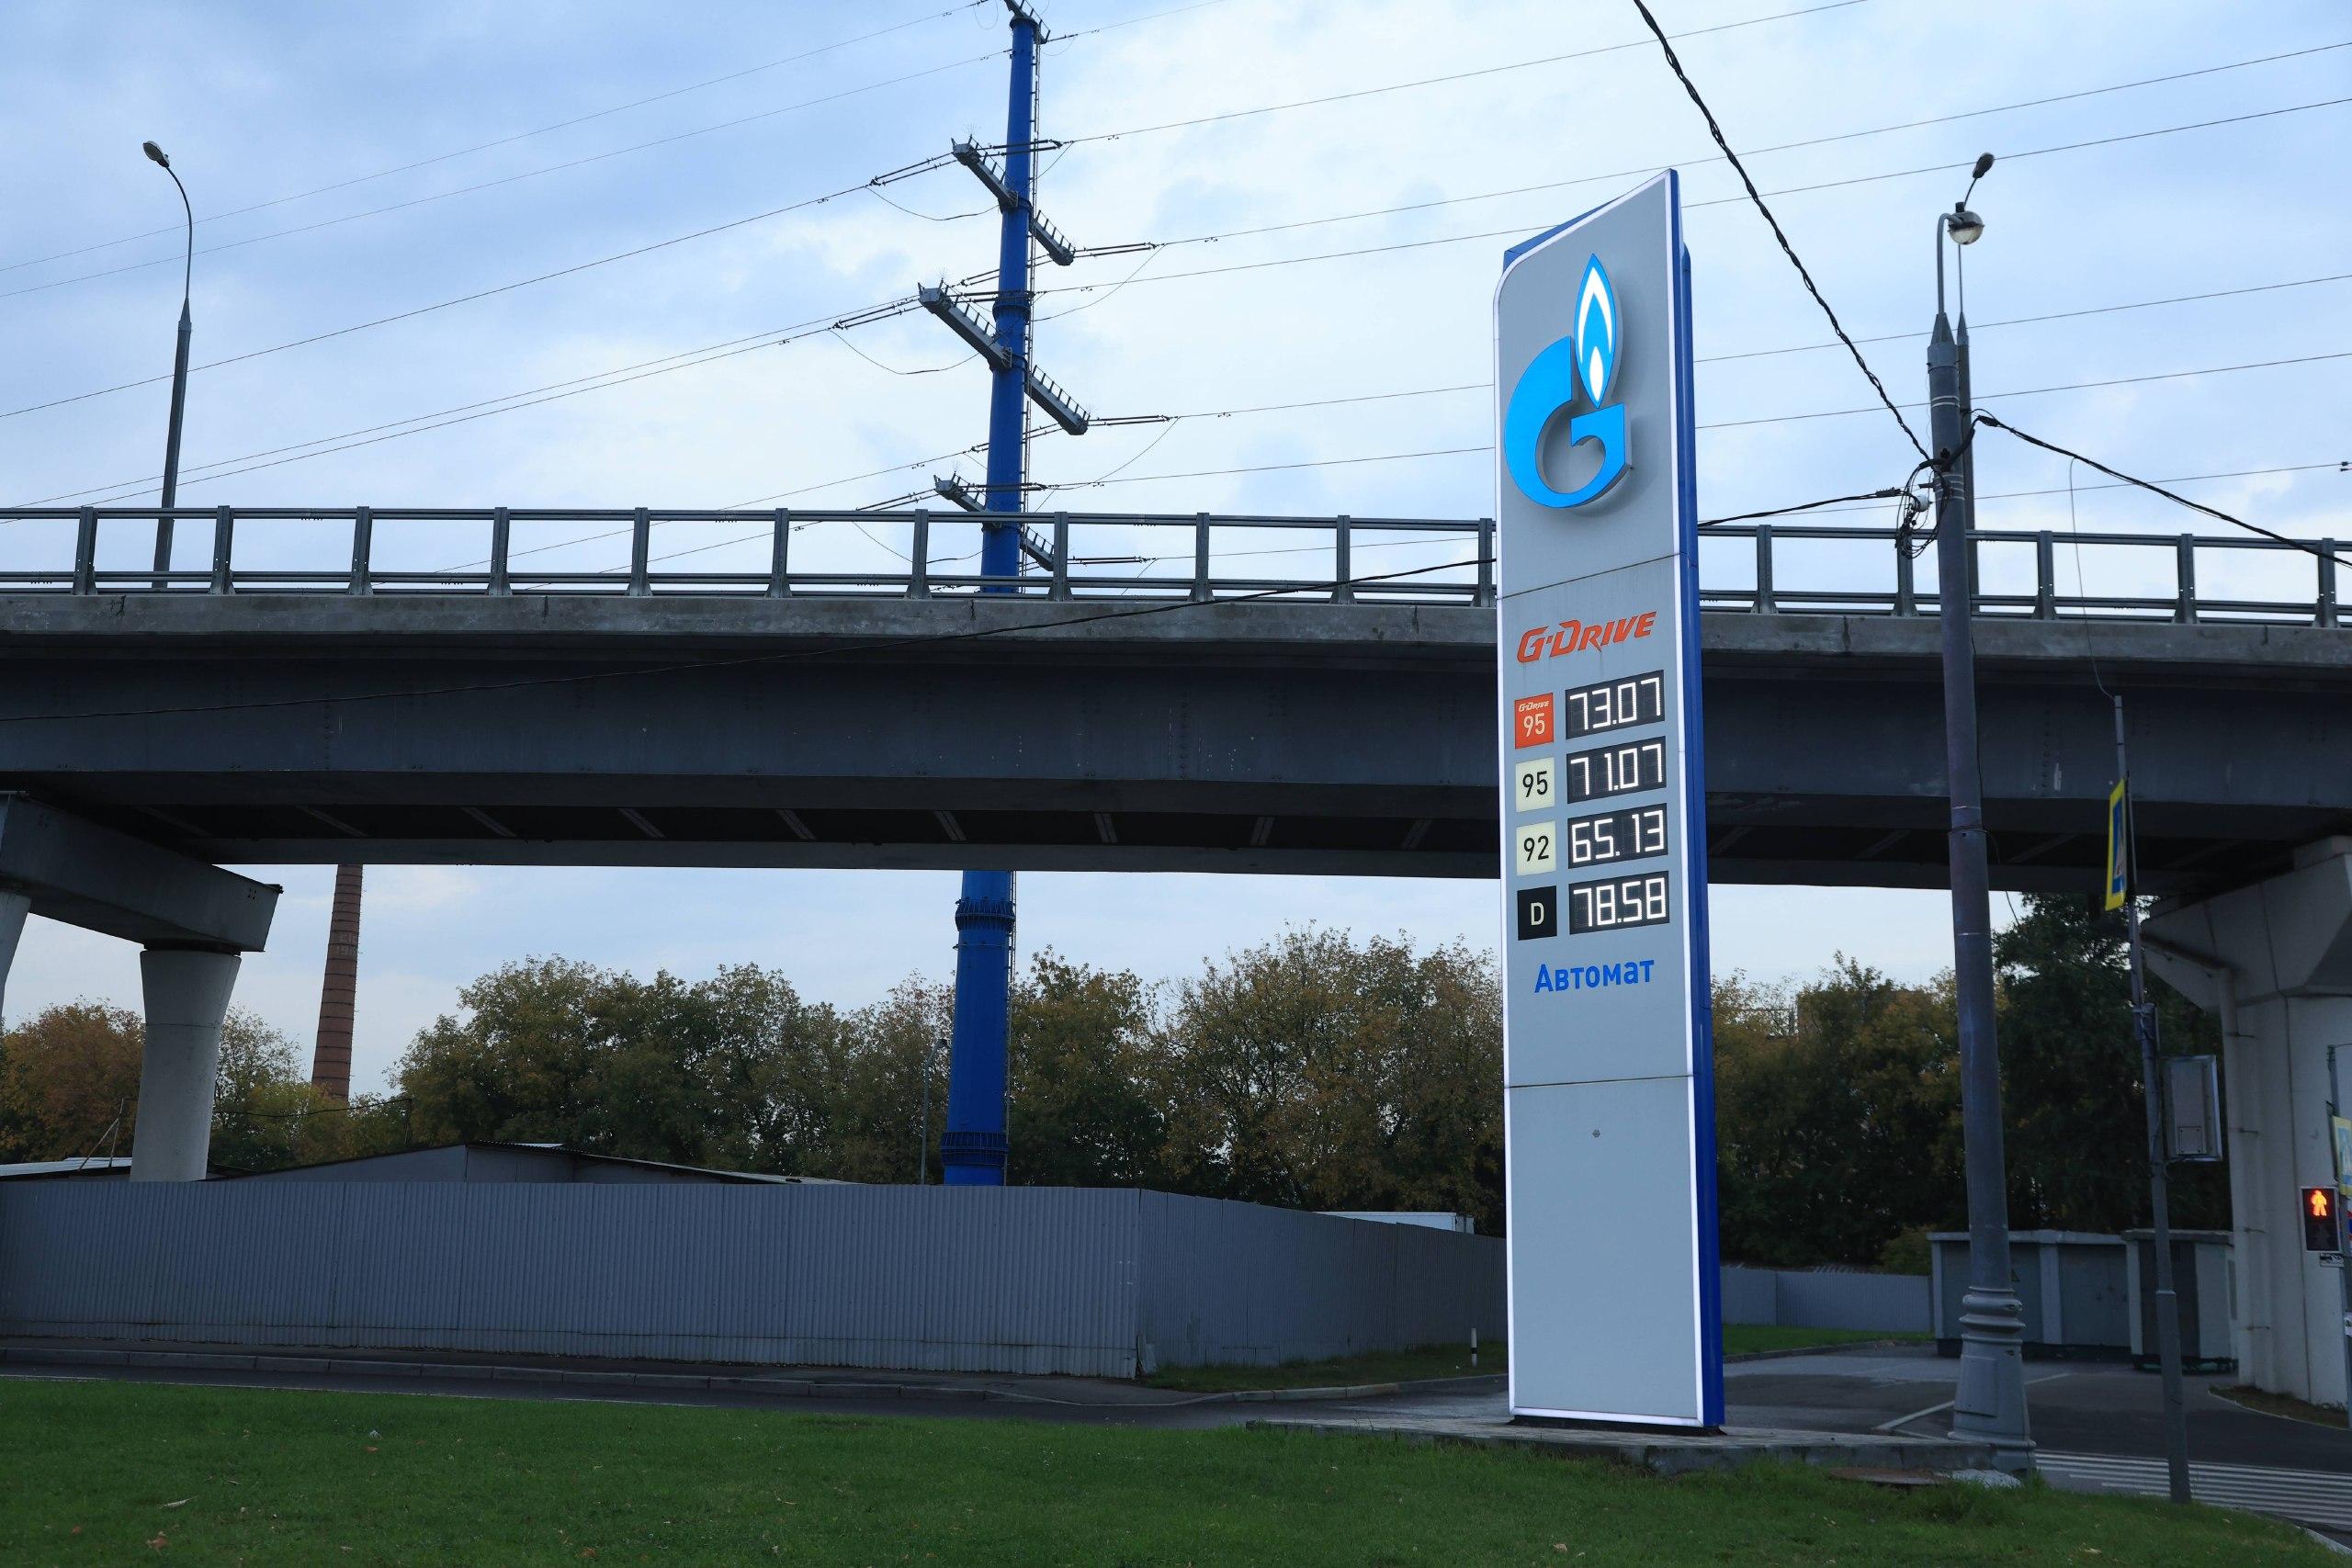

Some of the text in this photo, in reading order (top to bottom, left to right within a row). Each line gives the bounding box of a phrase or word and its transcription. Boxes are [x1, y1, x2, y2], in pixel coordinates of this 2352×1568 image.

[1569, 677, 1661, 730] 73.07
[1523, 713, 1545, 738] 95
[1522, 771, 1548, 798] 95
[1570, 743, 1663, 795] 71.07
[1523, 835, 1549, 862] 92
[1571, 809, 1665, 863] 65.13
[1530, 902, 1544, 926] D
[1573, 877, 1667, 928] 78.58
